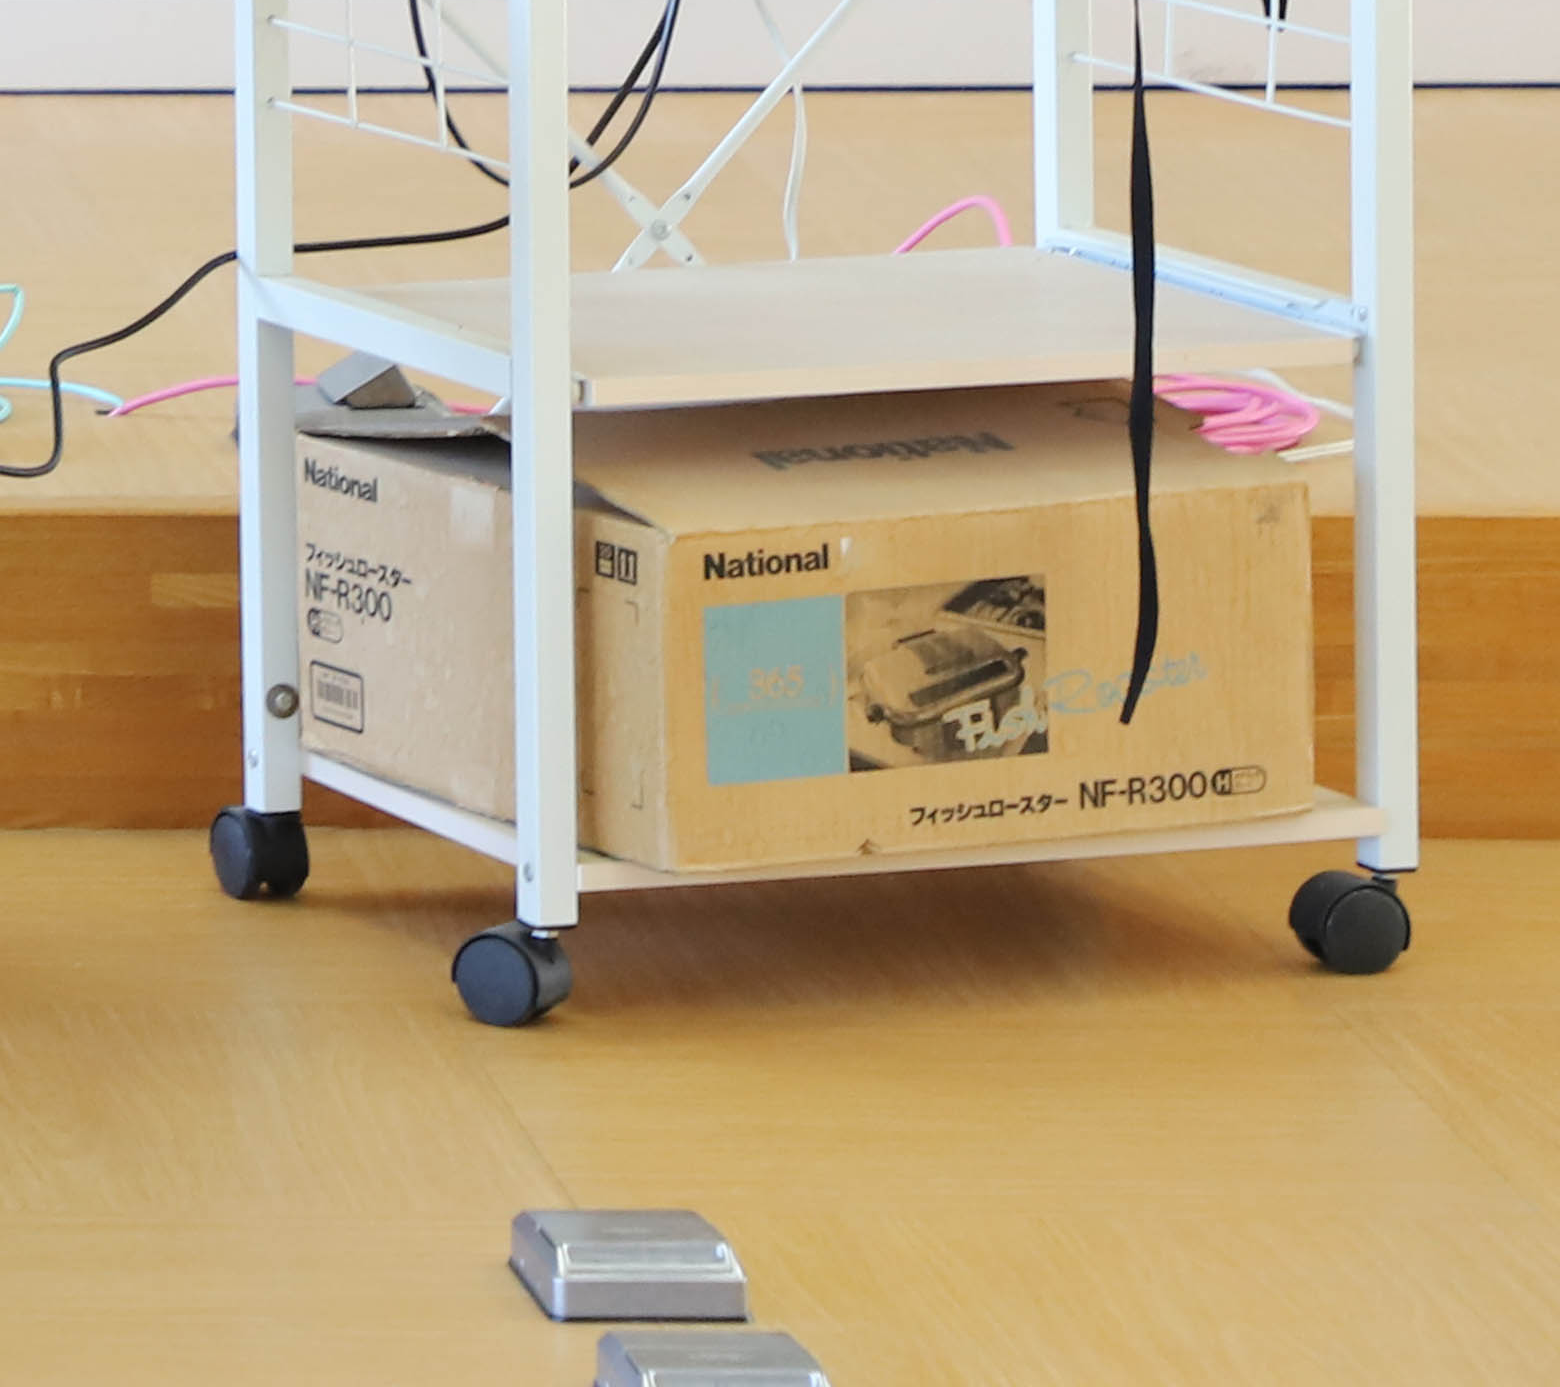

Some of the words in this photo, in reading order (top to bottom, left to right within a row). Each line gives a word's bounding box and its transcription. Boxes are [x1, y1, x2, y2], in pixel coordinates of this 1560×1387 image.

[753, 433, 1013, 470] National
[304, 457, 378, 502] National
[305, 543, 413, 587] フィッシュロースター
[703, 544, 829, 581] National
[305, 568, 392, 622] NF-R300
[909, 793, 1068, 829] フィッシュロースター
[1078, 770, 1206, 811] NF-R300
